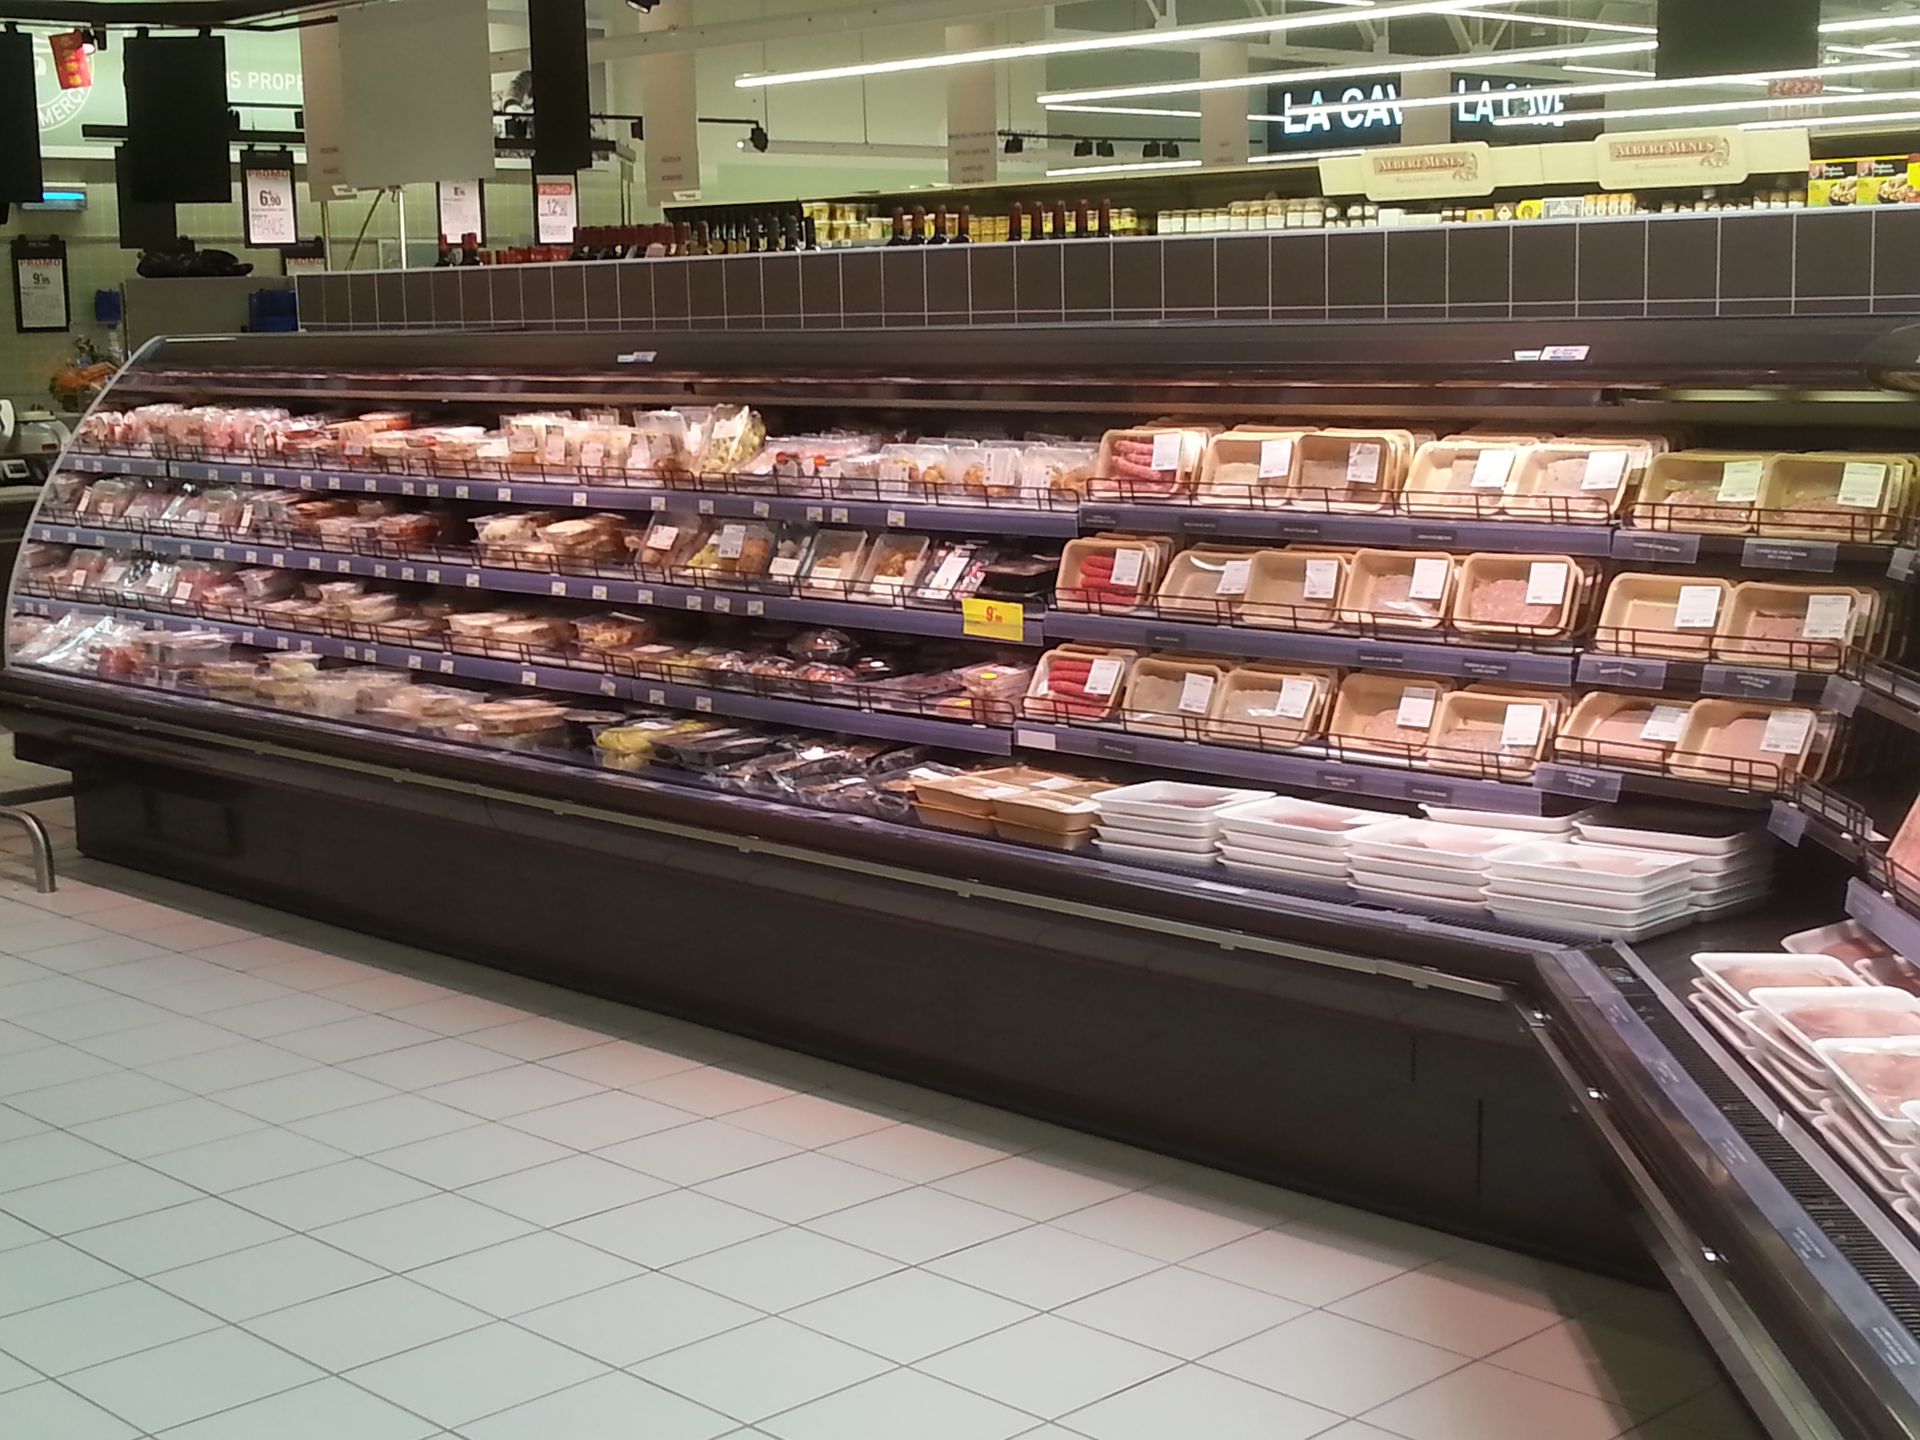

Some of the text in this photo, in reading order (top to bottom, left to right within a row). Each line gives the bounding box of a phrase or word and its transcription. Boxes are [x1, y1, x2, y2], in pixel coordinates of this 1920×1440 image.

[1459, 79, 1494, 123] LA
[1284, 91, 1331, 134] LA
[1616, 145, 1667, 157] ALBERT
[1380, 159, 1422, 171] ALBERT
[247, 169, 289, 178] PROMO
[538, 184, 571, 195] PROMO
